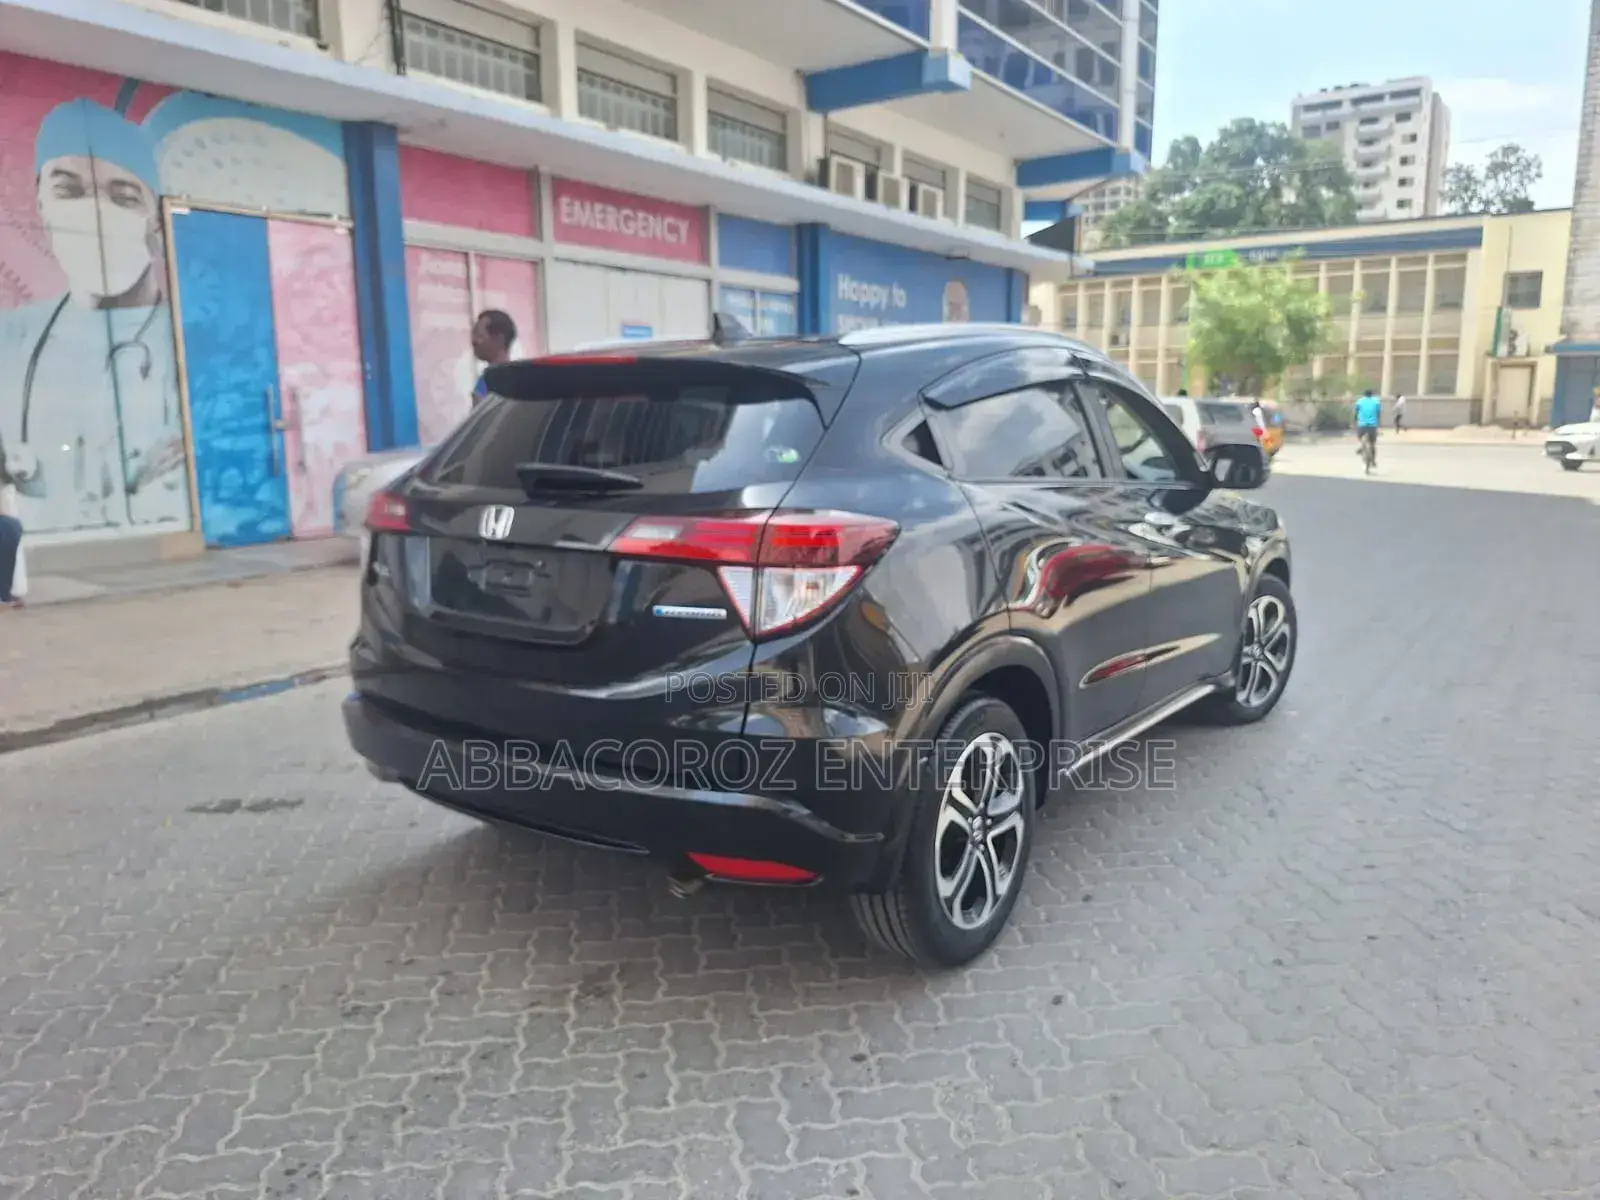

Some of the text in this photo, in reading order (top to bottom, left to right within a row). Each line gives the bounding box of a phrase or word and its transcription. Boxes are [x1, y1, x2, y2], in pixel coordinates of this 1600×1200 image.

[559, 193, 690, 246] EMERGENCY
[837, 272, 907, 312] Happy to
